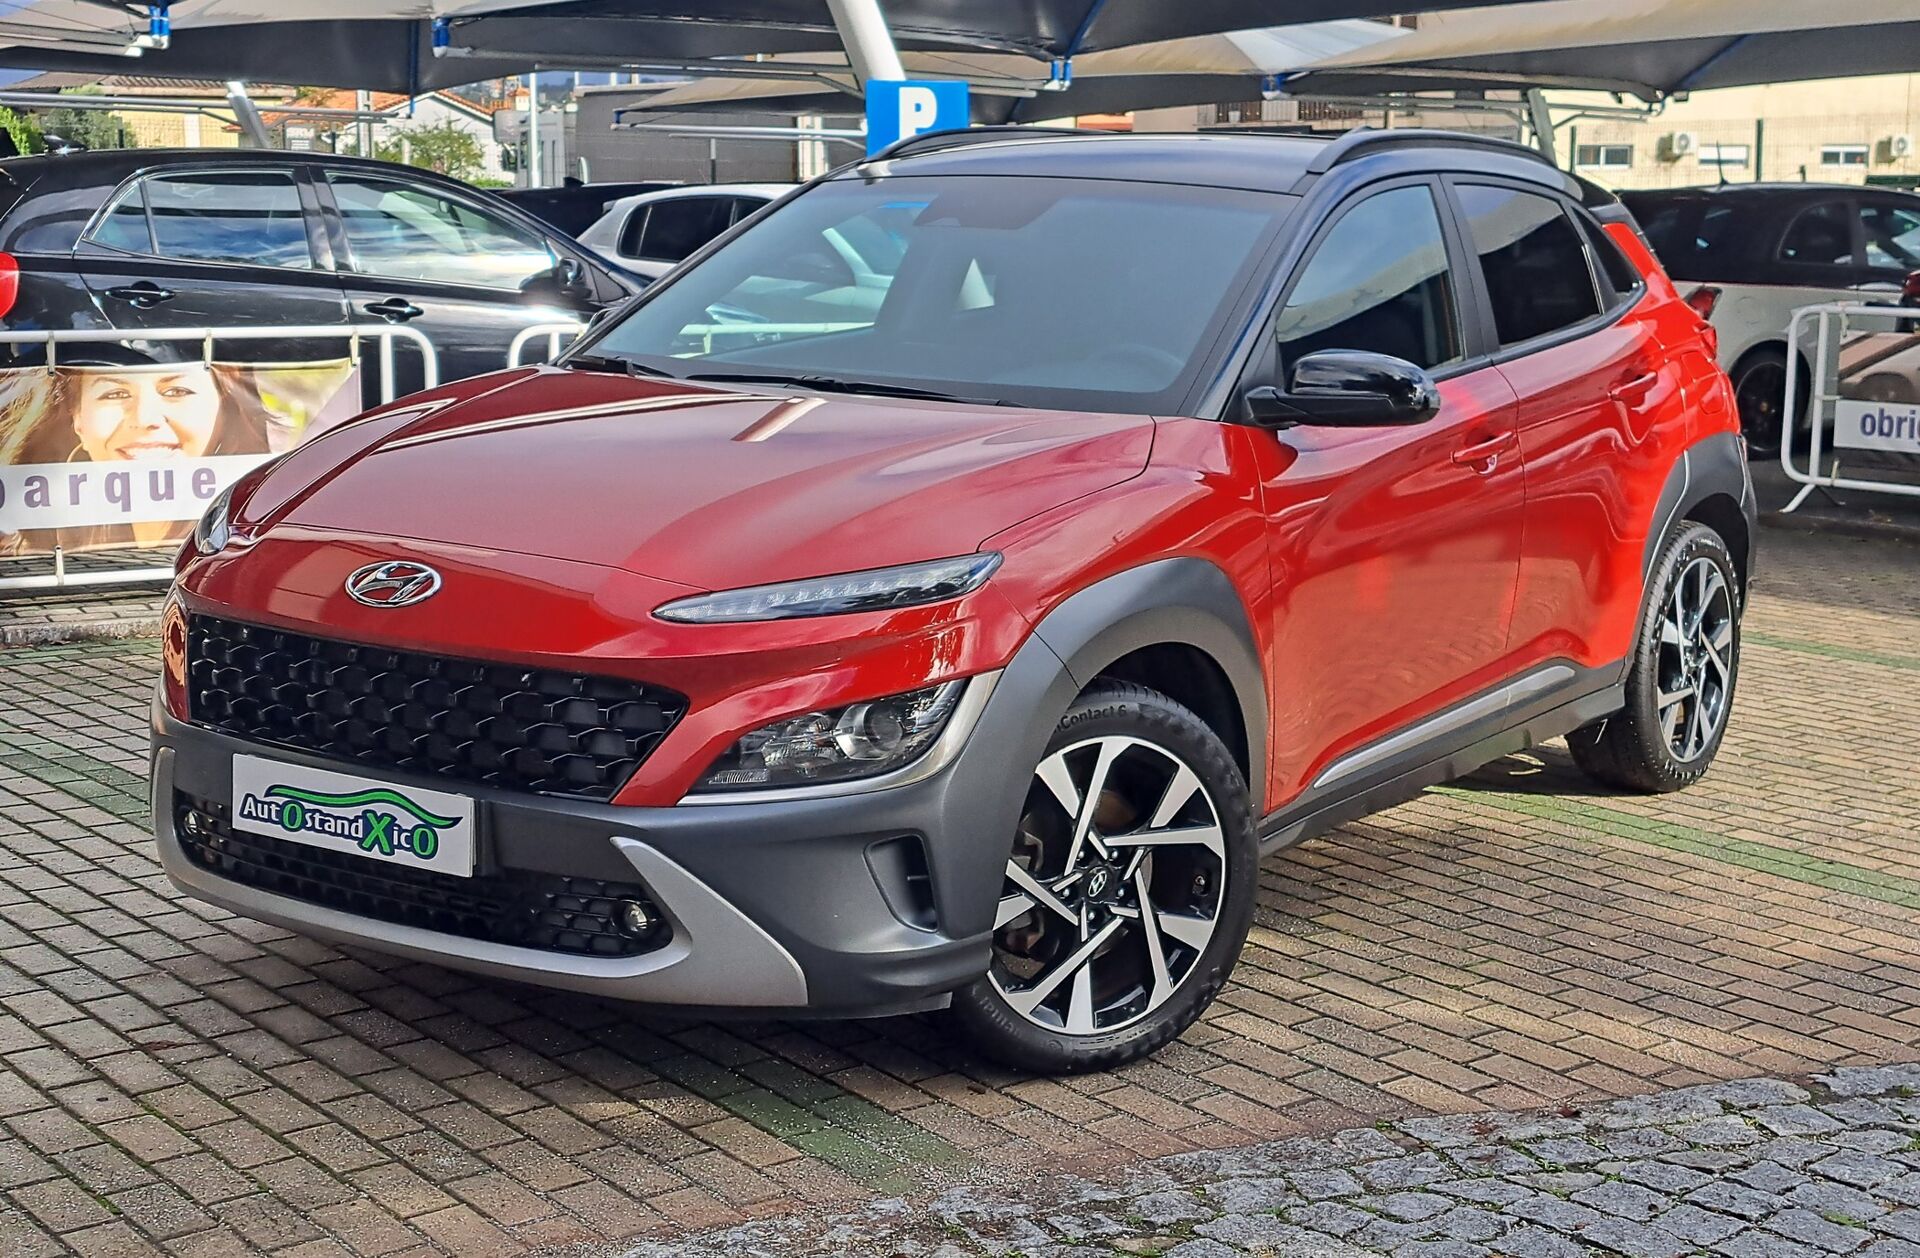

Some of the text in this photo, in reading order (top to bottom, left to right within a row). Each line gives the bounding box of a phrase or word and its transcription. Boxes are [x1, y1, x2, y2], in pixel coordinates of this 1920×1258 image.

[898, 86, 937, 140] P
[1860, 407, 1920, 447] obri
[0, 467, 216, 512] arque
[1056, 706, 1116, 732] Contact
